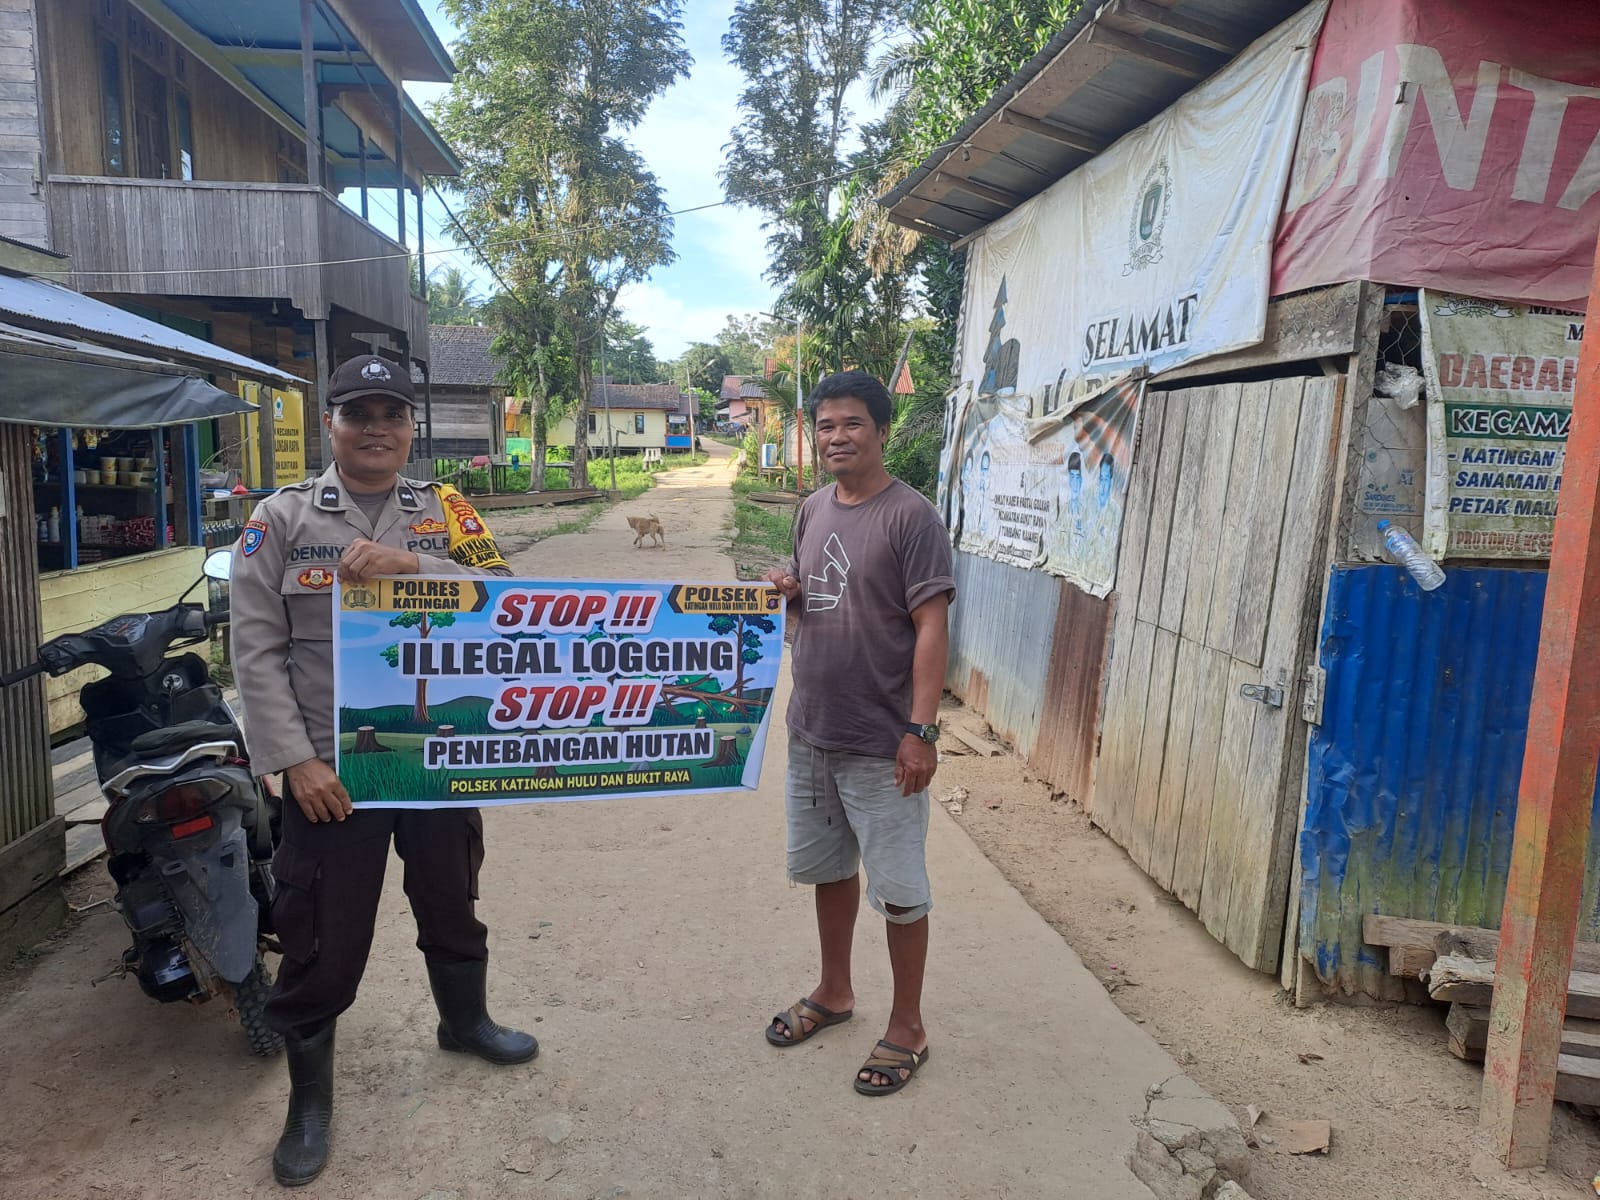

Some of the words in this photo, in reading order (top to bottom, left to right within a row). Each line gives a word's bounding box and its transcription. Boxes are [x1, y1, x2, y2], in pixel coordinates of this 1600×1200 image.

[1082, 293, 1198, 368] SELAMAT
[1462, 448, 1555, 467] KATINGAN
[1455, 472, 1548, 490] SANAMAN
[1449, 498, 1510, 515] PETAK
[290, 546, 345, 561] DENNY
[393, 581, 460, 597] POLRES
[685, 587, 758, 602] POLSEK
[393, 598, 460, 609] KATINGAN
[496, 594, 607, 627] STOP
[610, 596, 656, 627] !!!
[403, 642, 562, 675] ILLEGAL
[573, 641, 733, 673] LOGGING
[495, 685, 606, 722] STOP
[609, 685, 656, 719] !!!
[428, 736, 618, 765] PENEBANGAN
[626, 732, 710, 759] HUTAN
[451, 780, 497, 793] POLSEK
[501, 777, 563, 791] KATINGAN
[567, 775, 597, 789] HULU
[601, 773, 623, 787] DAN
[626, 771, 661, 785] BUKIT
[664, 770, 690, 783] RAYA
